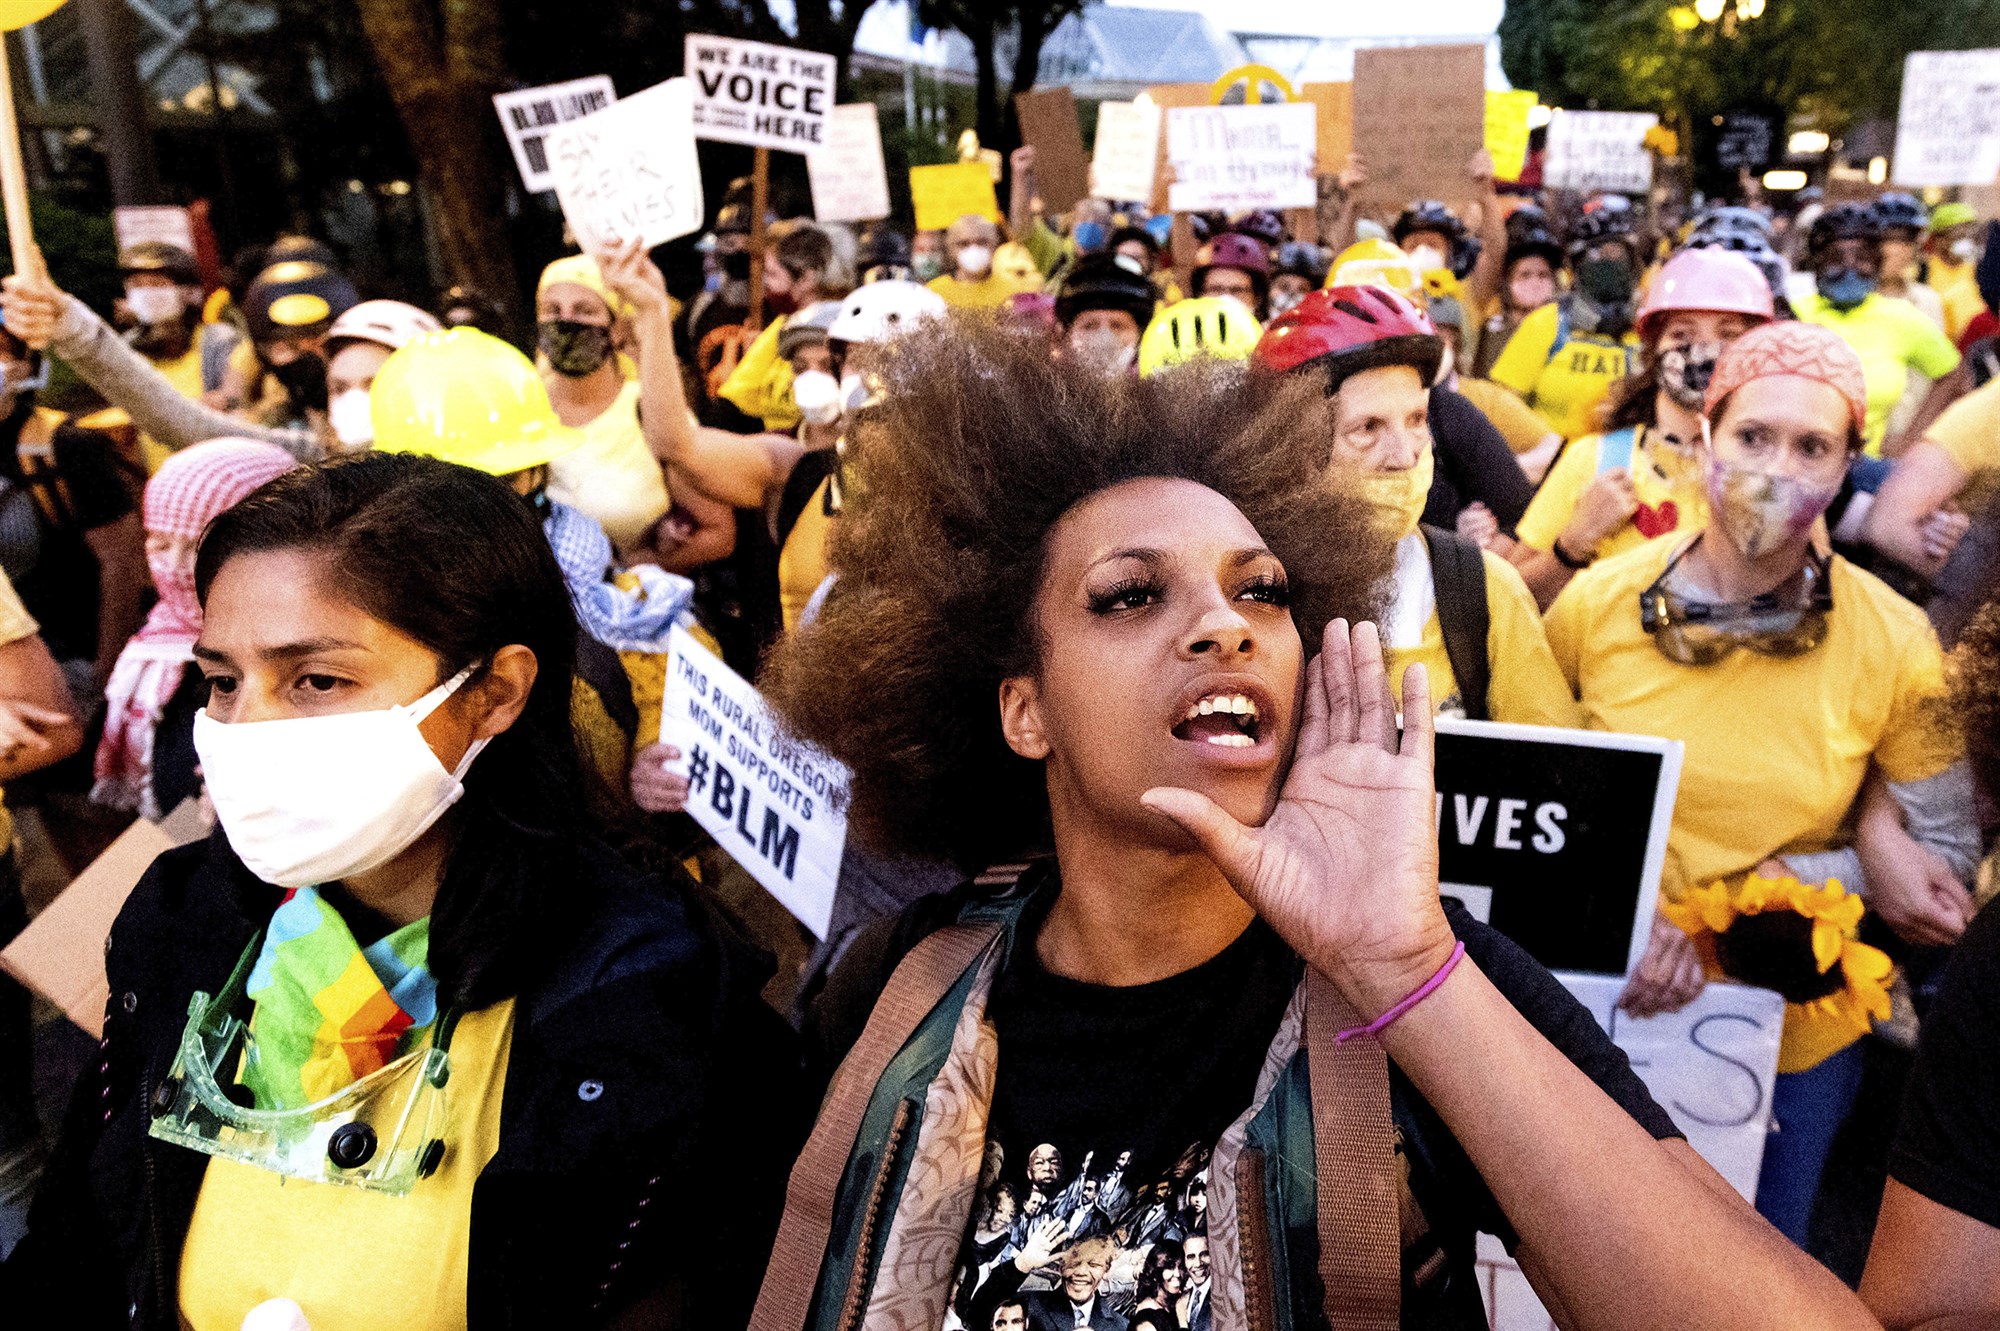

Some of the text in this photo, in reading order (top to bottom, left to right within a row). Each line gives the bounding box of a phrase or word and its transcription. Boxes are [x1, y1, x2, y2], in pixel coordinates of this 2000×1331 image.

[697, 68, 825, 116] VOICE
[698, 46, 825, 81] WE ARE THE
[754, 114, 823, 144] HERE
[677, 653, 707, 696] THIS
[711, 686, 762, 747] RURAL
[688, 698, 813, 821] MOM SUPPORTS
[688, 744, 800, 881] #BLM
